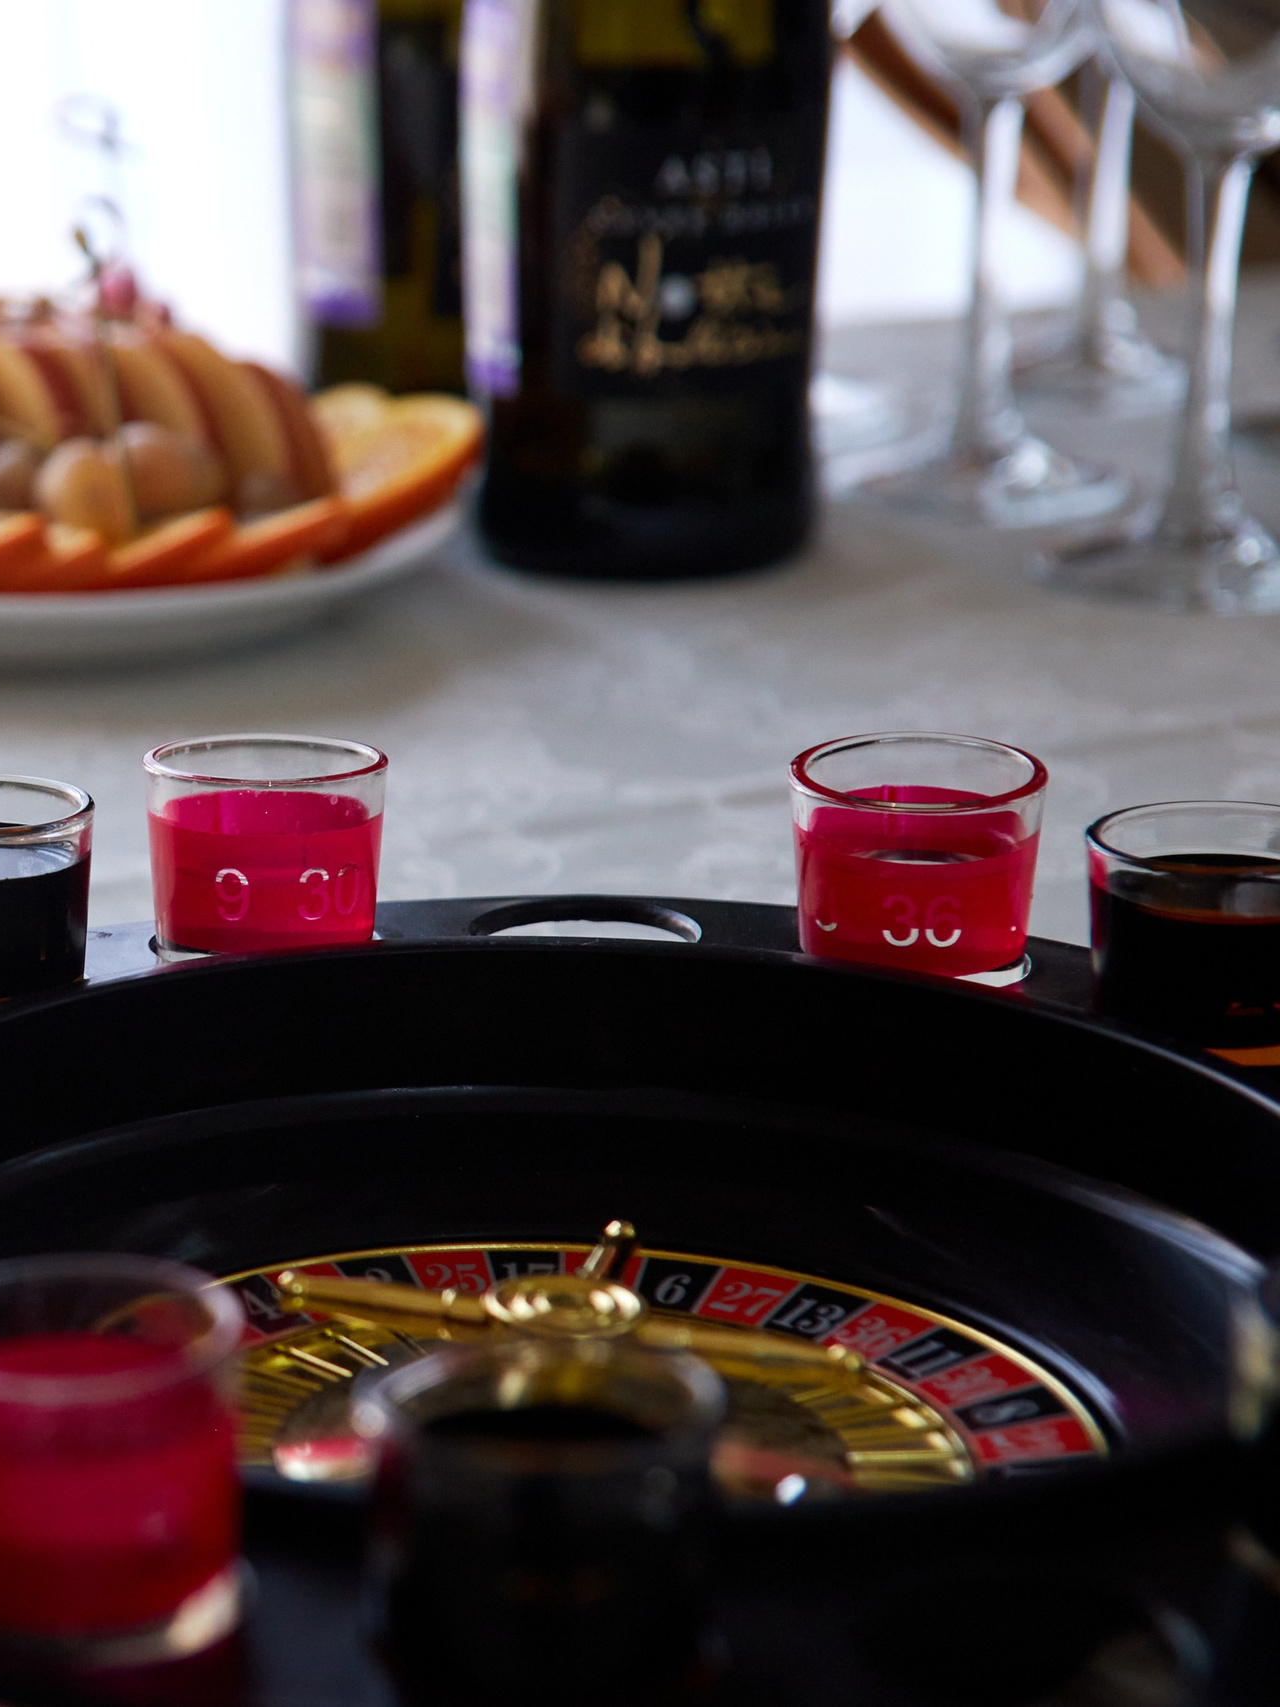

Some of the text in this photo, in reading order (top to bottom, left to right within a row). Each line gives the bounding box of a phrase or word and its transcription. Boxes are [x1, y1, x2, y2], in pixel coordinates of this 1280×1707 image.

[215, 862, 360, 921] 9 30
[882, 893, 963, 948] 36
[426, 1263, 485, 1294] 25
[655, 1273, 692, 1304] 6
[710, 1281, 784, 1317] 27
[771, 1297, 846, 1334] 13
[830, 1315, 911, 1355] 36
[887, 1338, 965, 1378] 11
